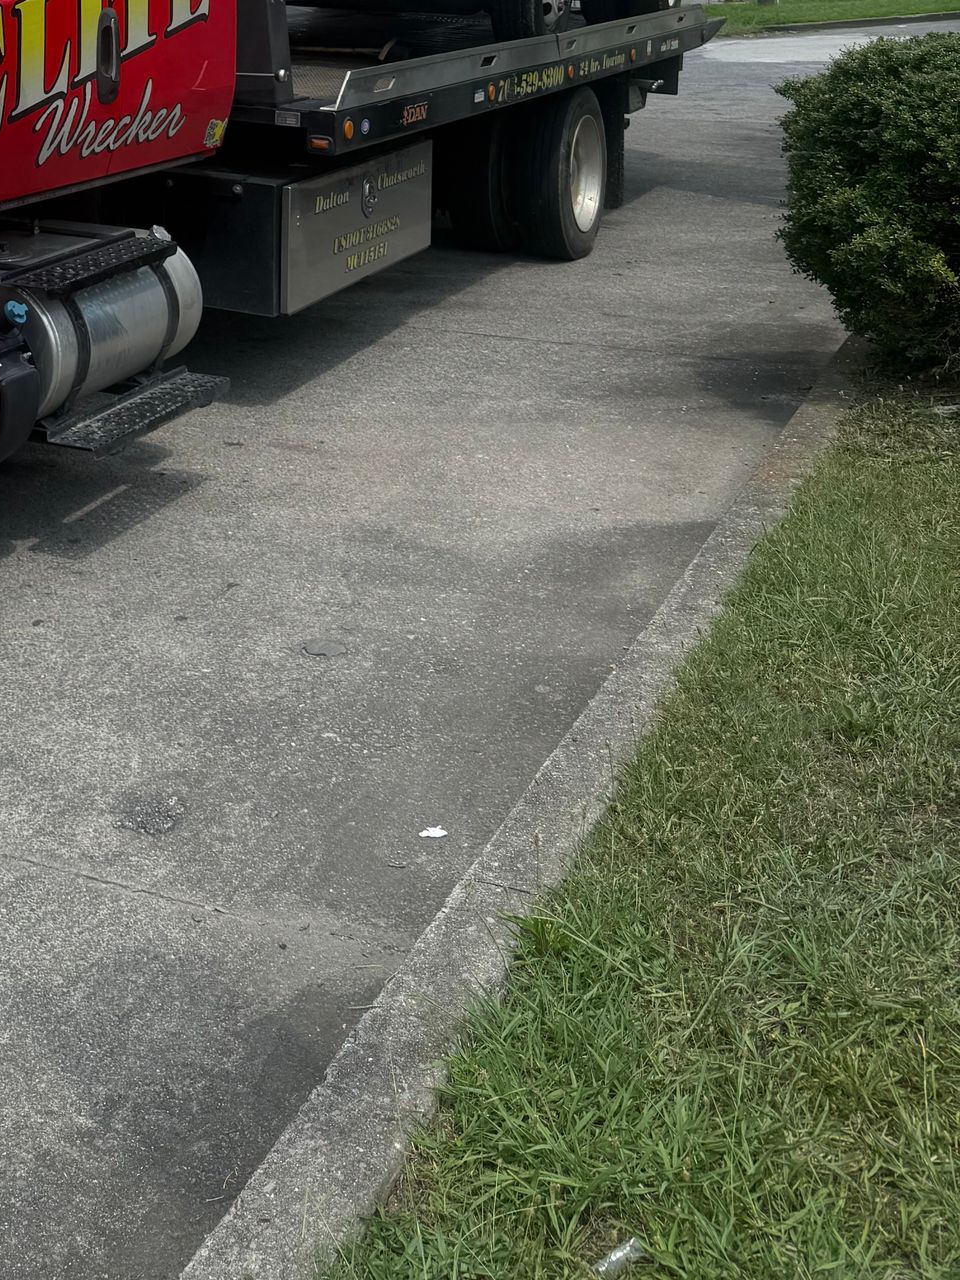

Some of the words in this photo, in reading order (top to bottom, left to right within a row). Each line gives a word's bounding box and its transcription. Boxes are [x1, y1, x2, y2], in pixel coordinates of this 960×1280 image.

[34, 78, 187, 167] Wrecker
[314, 191, 350, 215] Dalton
[333, 227, 366, 255] USDOT
